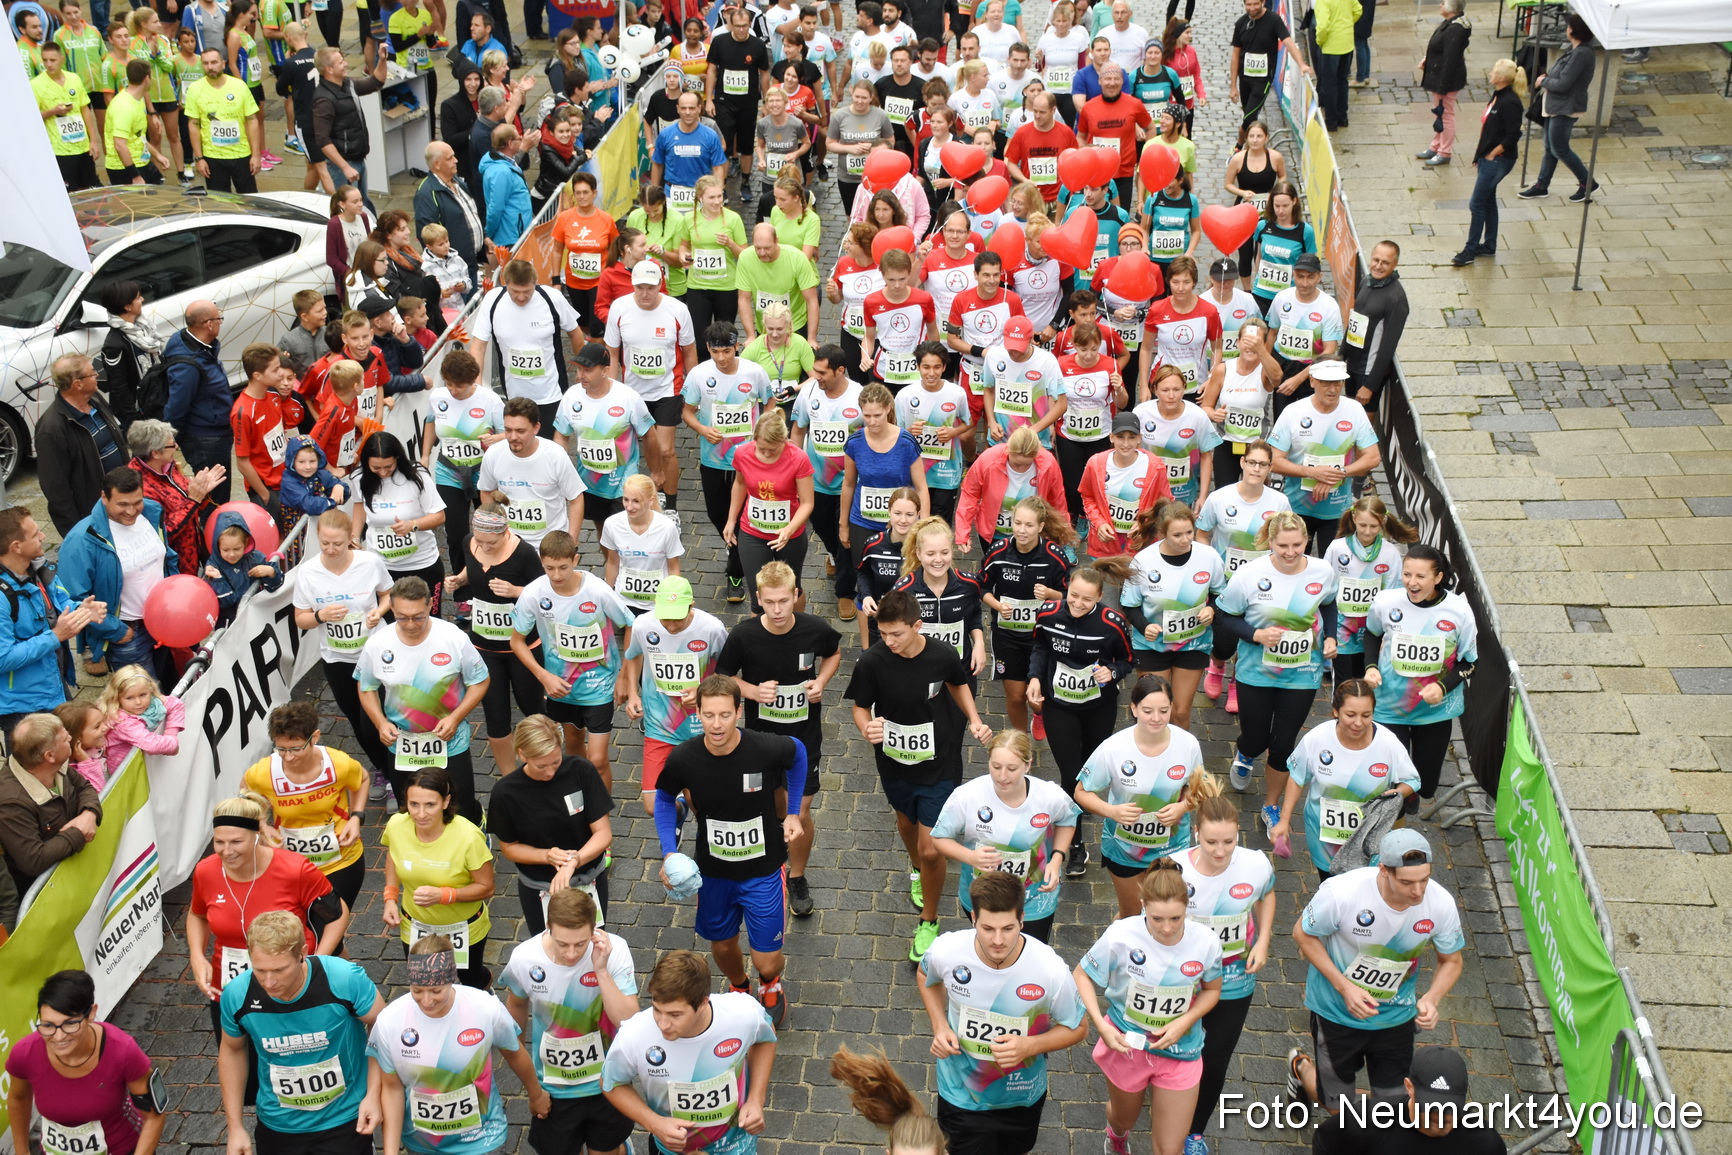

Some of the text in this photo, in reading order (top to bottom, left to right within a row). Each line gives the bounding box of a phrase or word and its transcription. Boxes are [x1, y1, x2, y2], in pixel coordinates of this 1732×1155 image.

[410, 48, 428, 57] 2881
[1246, 58, 1265, 67] 5073
[725, 77, 747, 86] 5115
[1049, 72, 1069, 81] 5012
[887, 104, 910, 115] 5280
[969, 115, 990, 126] 5149
[60, 121, 83, 133] 2826
[213, 127, 238, 138] 2905
[674, 145, 701, 155] HUBER
[1032, 164, 1054, 174] 5313
[673, 190, 696, 201] 5079
[1159, 216, 1184, 226] HUBER
[1156, 237, 1181, 249] 5080
[1265, 244, 1291, 257] HUBER
[572, 259, 597, 271] 5322
[696, 256, 723, 268] 5121
[1262, 268, 1288, 282] 5118
[1281, 333, 1309, 349] 5123
[511, 355, 542, 368] 5273
[633, 355, 662, 367] 5220
[889, 359, 917, 372] 5173
[1000, 388, 1028, 403] 5225
[717, 411, 749, 424] 5226
[1070, 416, 1099, 428] 5120
[1229, 413, 1261, 427] 5308
[814, 430, 845, 443] 5229
[447, 443, 481, 458] 5108
[580, 447, 613, 461] 5109
[758, 481, 774, 490] WE
[508, 507, 542, 521] 5143
[752, 507, 786, 520] 5113
[377, 534, 413, 549] 5058
[879, 567, 896, 576] Götz
[1002, 573, 1020, 582] Götz
[625, 577, 660, 593] 5023
[1342, 587, 1378, 602] 5029
[476, 610, 512, 626] 5160
[326, 621, 362, 639] 5007
[1179, 631, 1194, 639] Anne
[335, 640, 358, 648] Barbara
[560, 633, 599, 649] 5172
[1269, 639, 1309, 655] 5009
[1052, 642, 1070, 653] Götz
[1396, 643, 1440, 661] 5083
[433, 655, 450, 664] Hervis
[1275, 656, 1299, 664] Monika
[655, 662, 695, 680] 5078
[1402, 664, 1431, 672] Nadezda
[667, 683, 683, 691] Leon
[1058, 672, 1097, 691] 5044
[1063, 691, 1091, 700] Christina
[402, 738, 443, 755] 5140
[888, 731, 930, 750] 5168
[900, 752, 916, 760] Felix
[278, 786, 337, 807] MAX BÖGL
[286, 834, 334, 853] 5252
[714, 828, 759, 847] 5010
[1126, 835, 1156, 844] Johanna
[722, 848, 752, 856] Andreas
[1231, 886, 1251, 896] Hervis
[105, 922, 152, 975] einkaufen leben
[1127, 966, 1145, 974] PARTL
[1183, 964, 1201, 974] Hervis
[1225, 965, 1239, 973] 17.
[1352, 964, 1402, 989] 5097
[951, 984, 971, 995] PARTL
[1019, 987, 1042, 997] Hervis
[1133, 993, 1186, 1015] 5142
[1145, 1016, 1166, 1026] Lena
[262, 1031, 327, 1049] HUBER
[460, 1032, 482, 1042] Hervis
[717, 1041, 739, 1054] Hervis
[546, 1044, 598, 1068] 5234
[561, 1068, 587, 1078] Dustin
[1008, 1073, 1024, 1081] 17.
[280, 1070, 338, 1096] 5100
[293, 1094, 330, 1105] Thomas
[677, 1084, 731, 1110] 5231
[417, 1097, 474, 1120] 5275
[690, 1111, 723, 1121] Florian
[430, 1120, 462, 1131] Andrea
[46, 1126, 100, 1153] 5304
